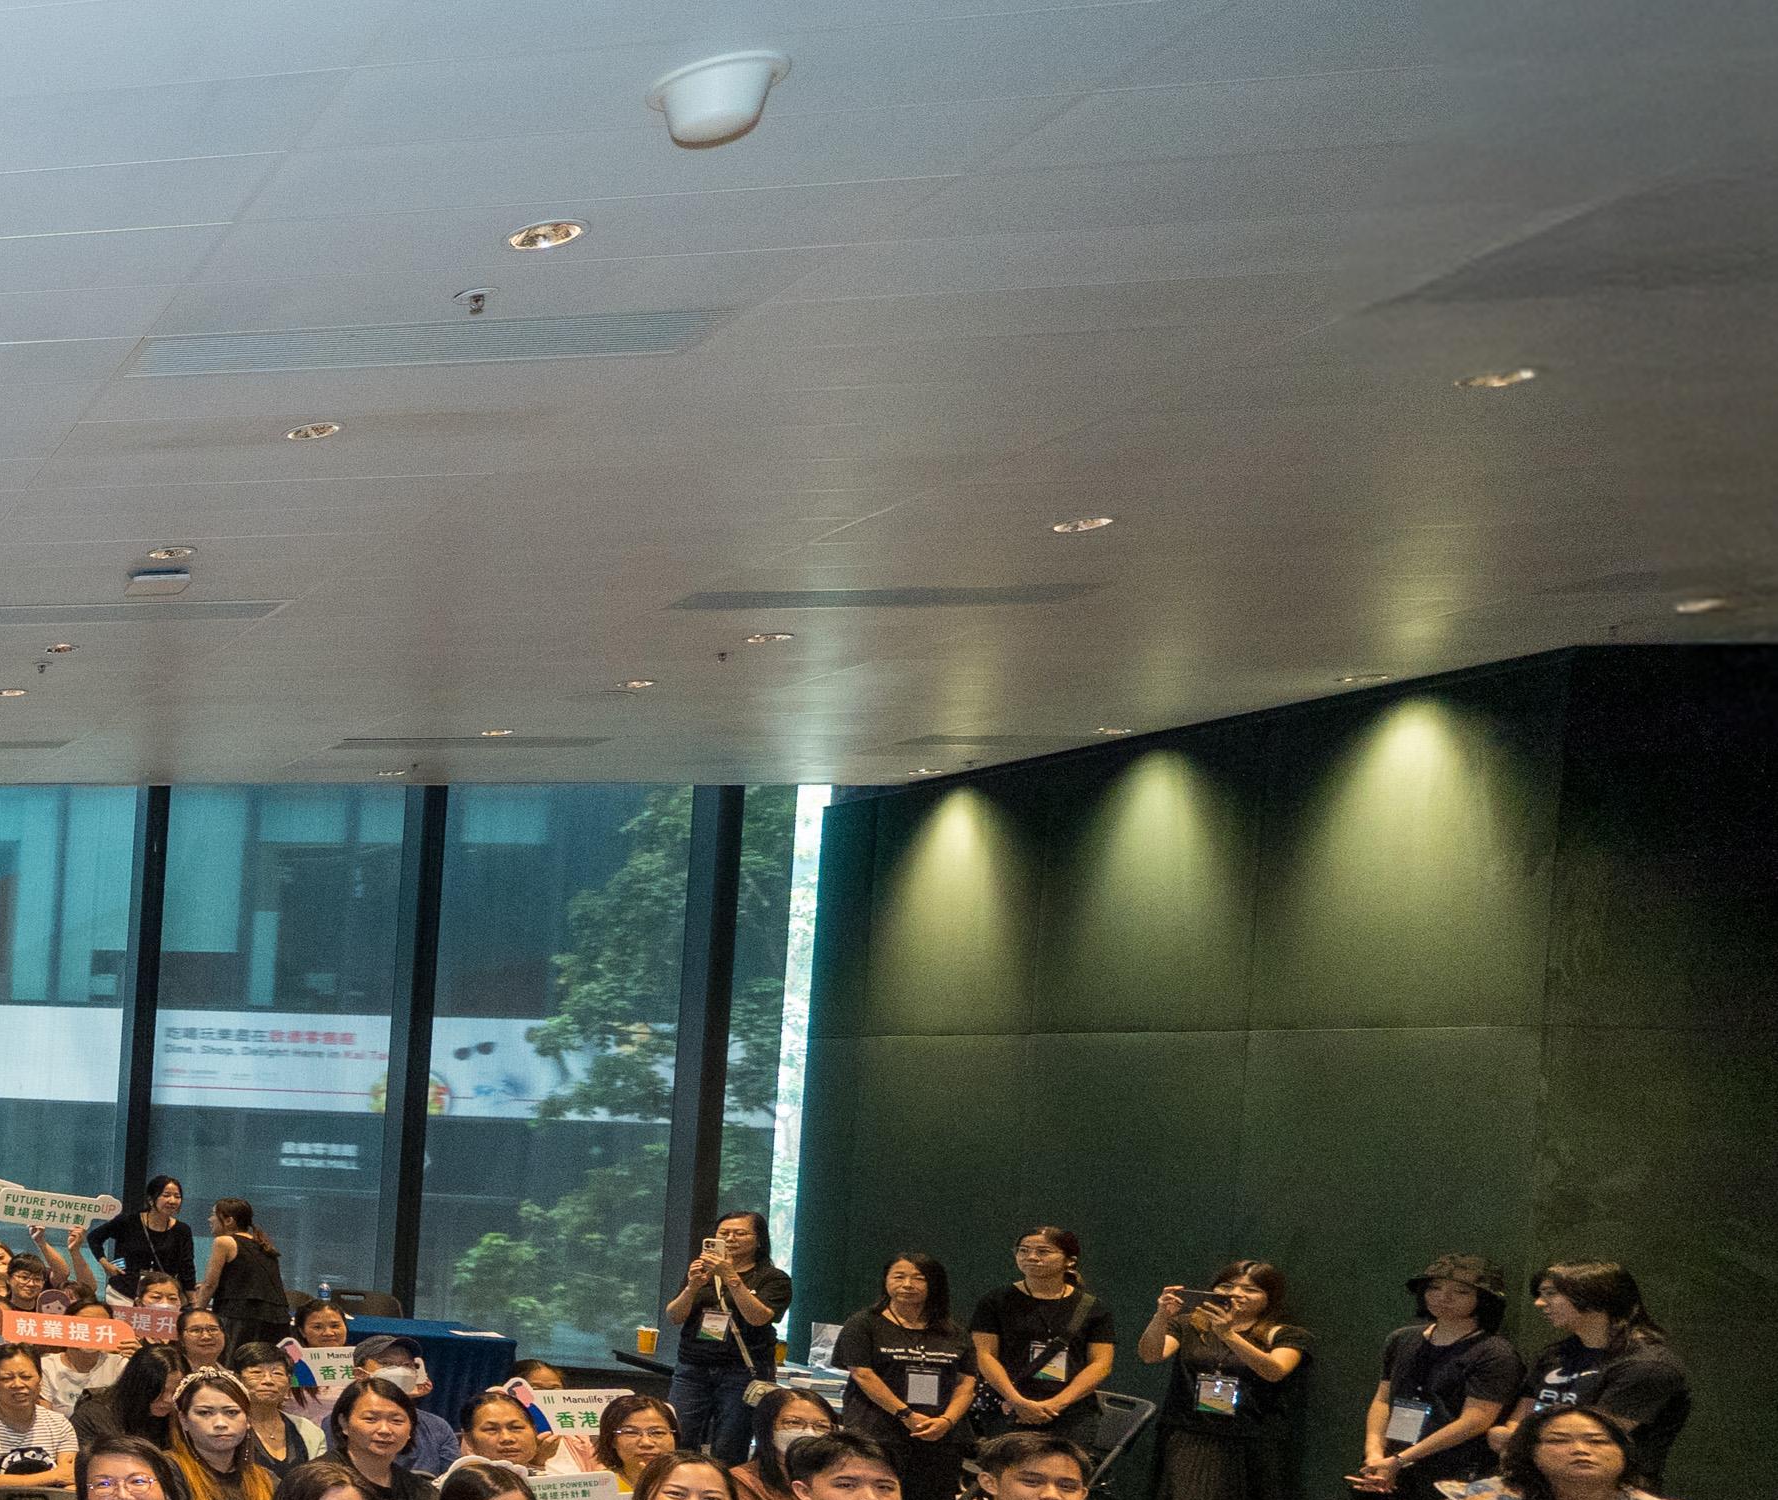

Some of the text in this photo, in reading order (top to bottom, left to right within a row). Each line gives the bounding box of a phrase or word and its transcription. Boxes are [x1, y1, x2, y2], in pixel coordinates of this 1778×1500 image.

[5, 1193, 47, 1207] FUTURE
[3, 1205, 86, 1226] 職場提升計劃
[15, 1317, 118, 1344] 就業提升
[562, 1395, 604, 1404] Manulife
